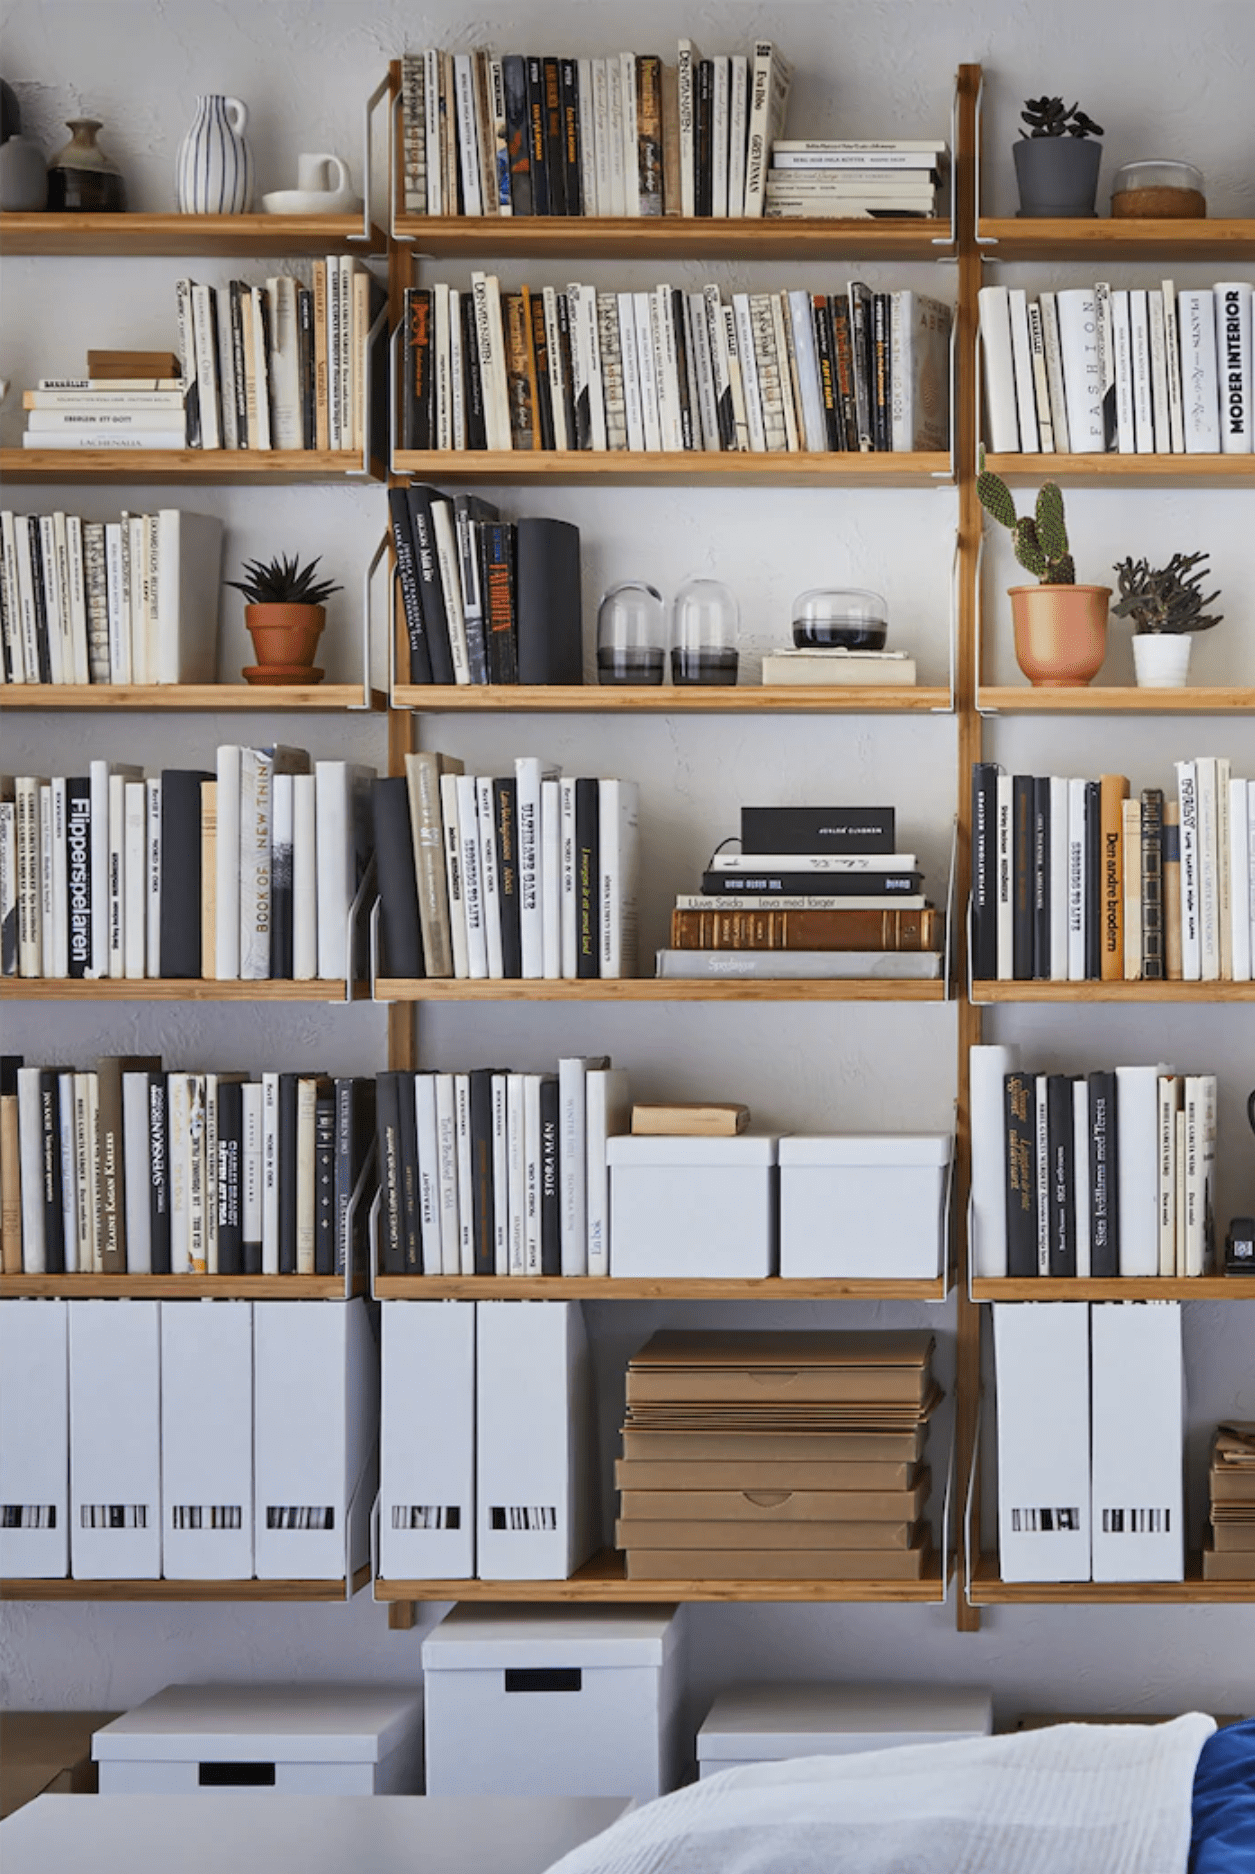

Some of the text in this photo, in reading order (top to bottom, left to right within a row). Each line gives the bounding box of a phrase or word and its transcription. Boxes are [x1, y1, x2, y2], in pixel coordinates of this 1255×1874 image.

[1225, 291, 1244, 434] MODER INTERIOR
[257, 812, 268, 849] NEW
[521, 803, 535, 870] ULTIMATE
[67, 798, 91, 961] Flipperspelaren
[256, 866, 269, 886] OF
[1107, 832, 1119, 952] Den andre brodern
[256, 892, 269, 933] BOOK
[151, 1122, 164, 1186] SVENSKAN
[1094, 1136, 1105, 1161] med
[544, 1157, 555, 1196] STORA
[1095, 1219, 1107, 1246] Sista
